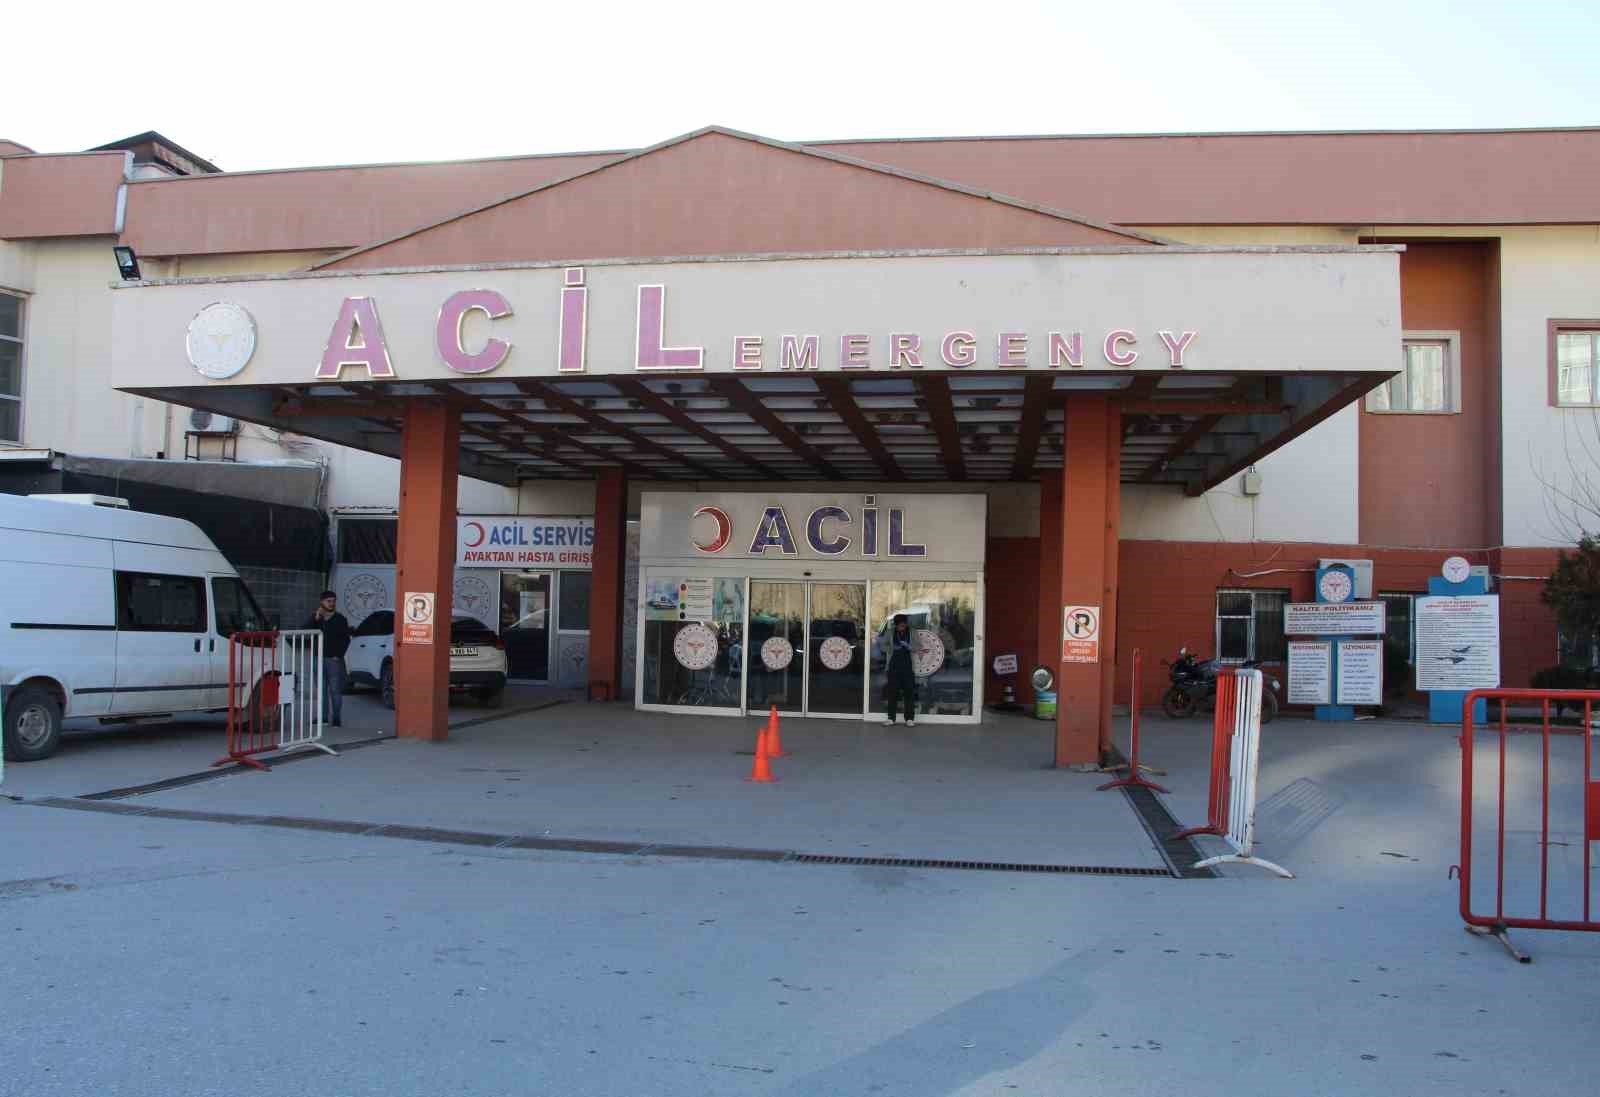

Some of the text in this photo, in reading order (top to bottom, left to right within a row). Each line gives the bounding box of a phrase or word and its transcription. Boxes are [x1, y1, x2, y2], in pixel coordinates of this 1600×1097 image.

[315, 267, 1199, 379] ACİL EMERGENCY
[489, 521, 594, 546] ACİL SERVİS
[749, 495, 927, 557] ACİL
[464, 551, 513, 562] AYAKTAN
[519, 551, 554, 563] HASTA
